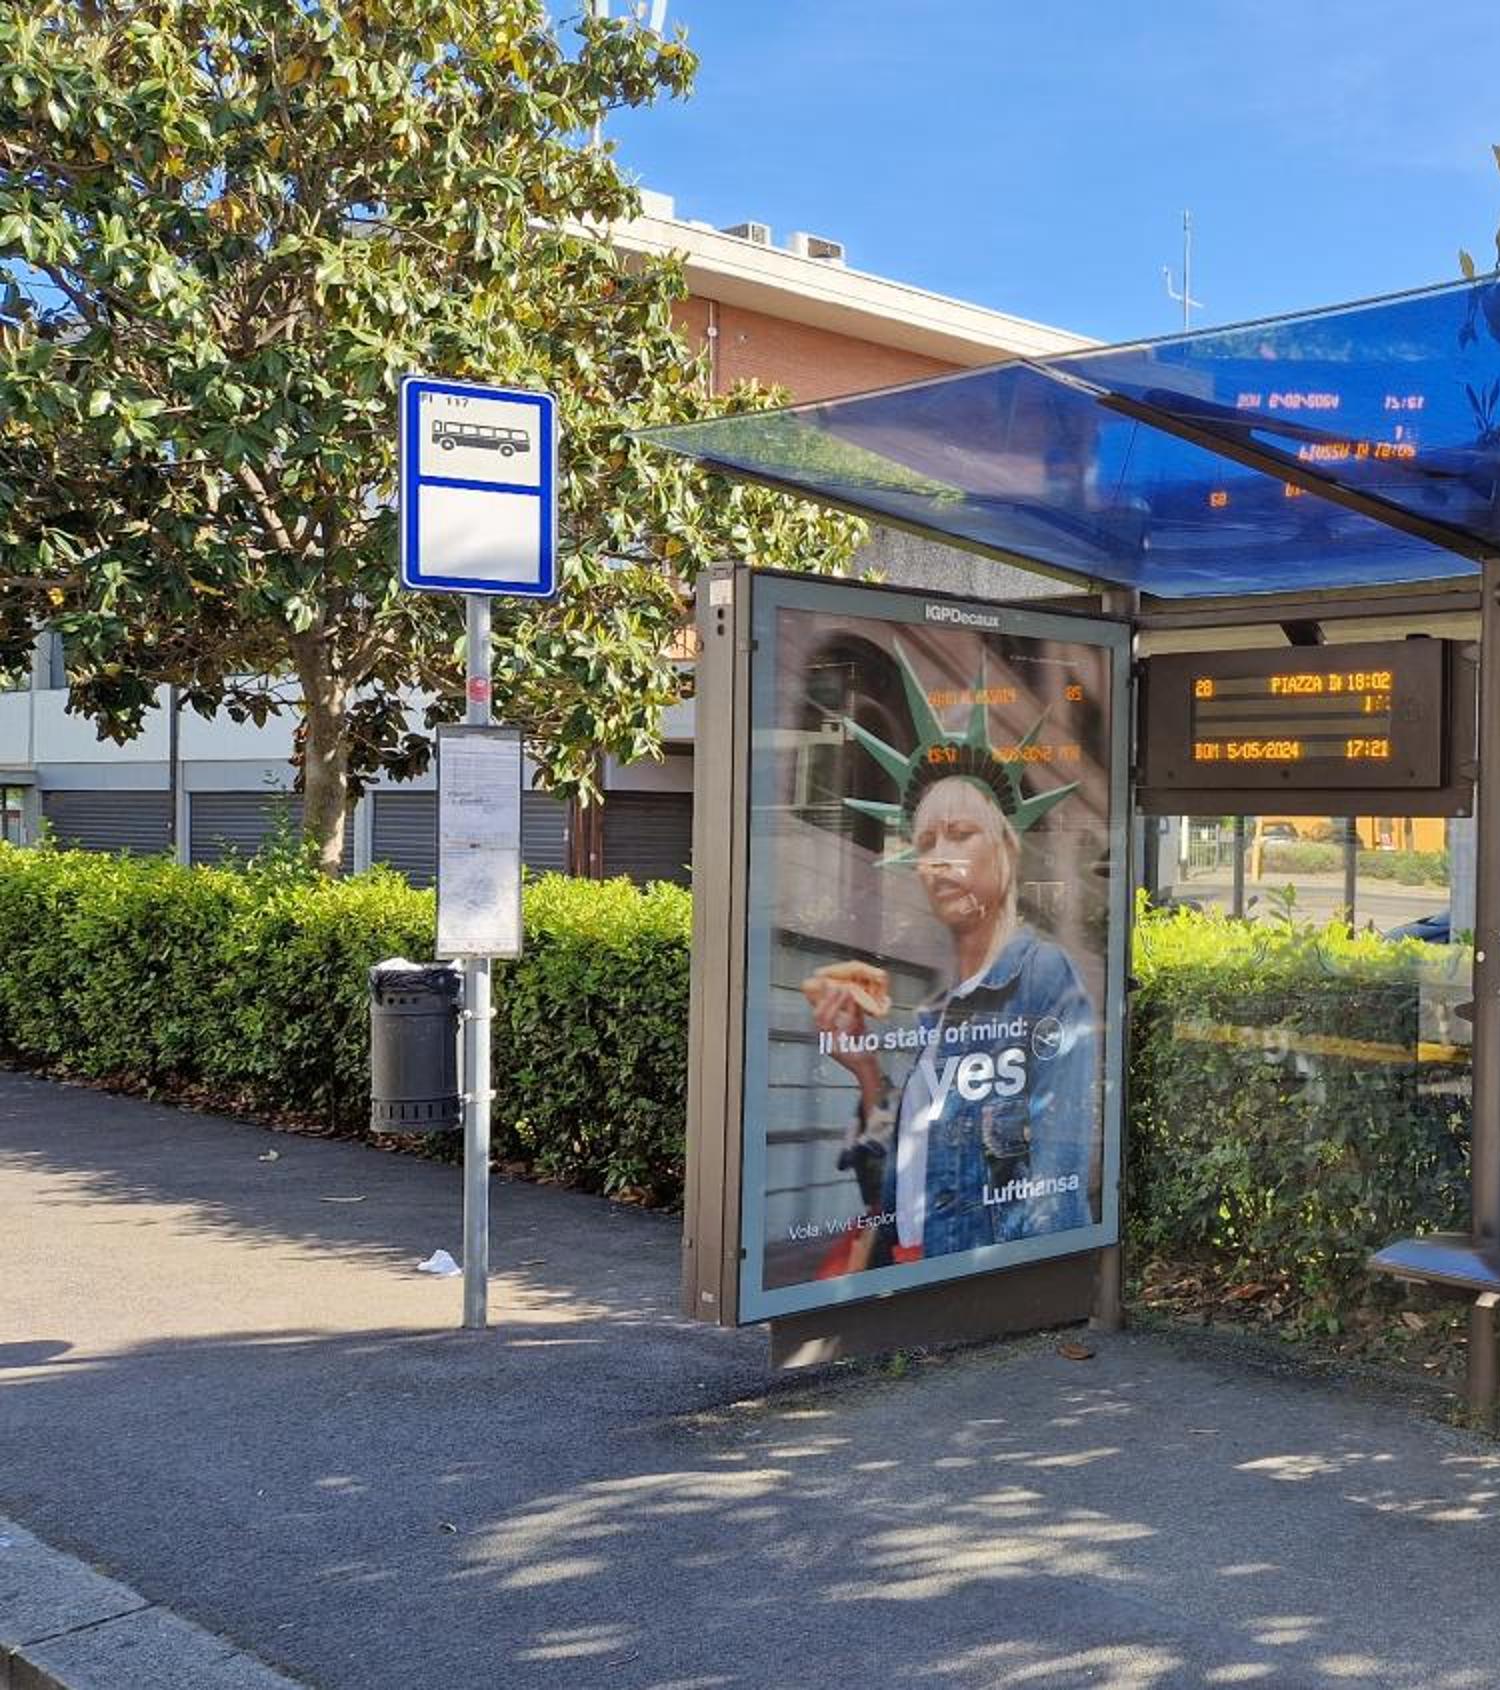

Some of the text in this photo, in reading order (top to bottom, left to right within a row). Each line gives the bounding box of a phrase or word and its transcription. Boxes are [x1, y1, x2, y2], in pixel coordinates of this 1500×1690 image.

[925, 603, 999, 627] IGPDecaux
[1195, 678, 1214, 698] 28
[1270, 673, 1323, 694] PIAZZA
[1347, 671, 1391, 691] 18:02
[1227, 740, 1299, 760] 5/05/2024
[1347, 739, 1389, 758] 17:21
[819, 1016, 1029, 1054] Il tuo state of mind:
[919, 1047, 1027, 1121] yes
[983, 1174, 1080, 1206] Lufthansa
